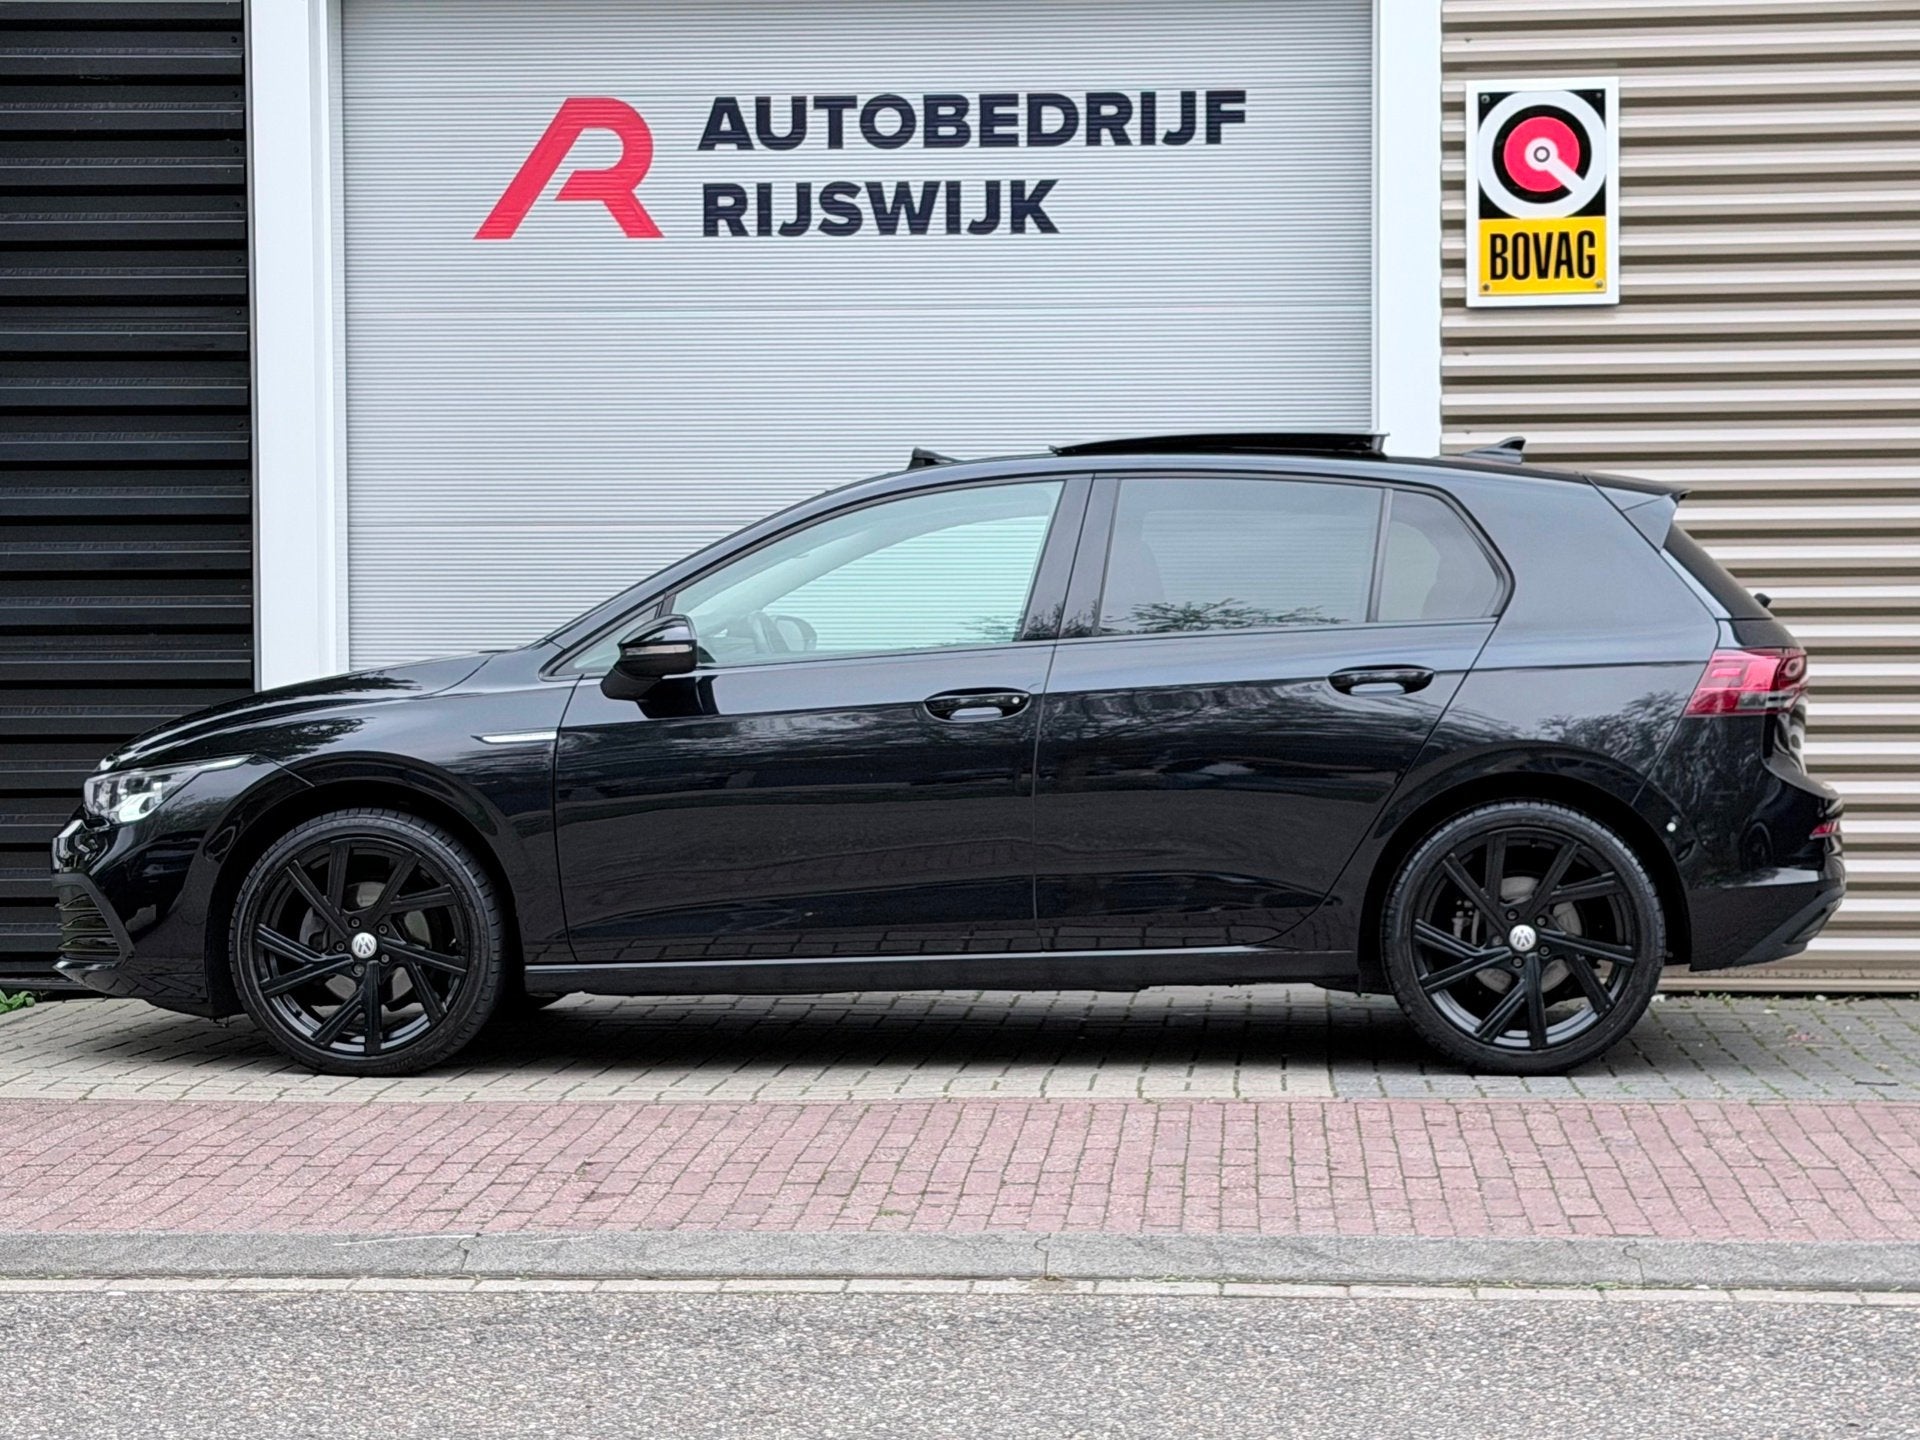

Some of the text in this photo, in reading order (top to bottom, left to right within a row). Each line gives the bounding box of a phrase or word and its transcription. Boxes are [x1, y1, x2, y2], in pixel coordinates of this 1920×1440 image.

[698, 90, 1246, 151] AUTOBEDRIJF
[703, 179, 1058, 237] RIJSWIJK
[1490, 230, 1596, 280] BOVAG
